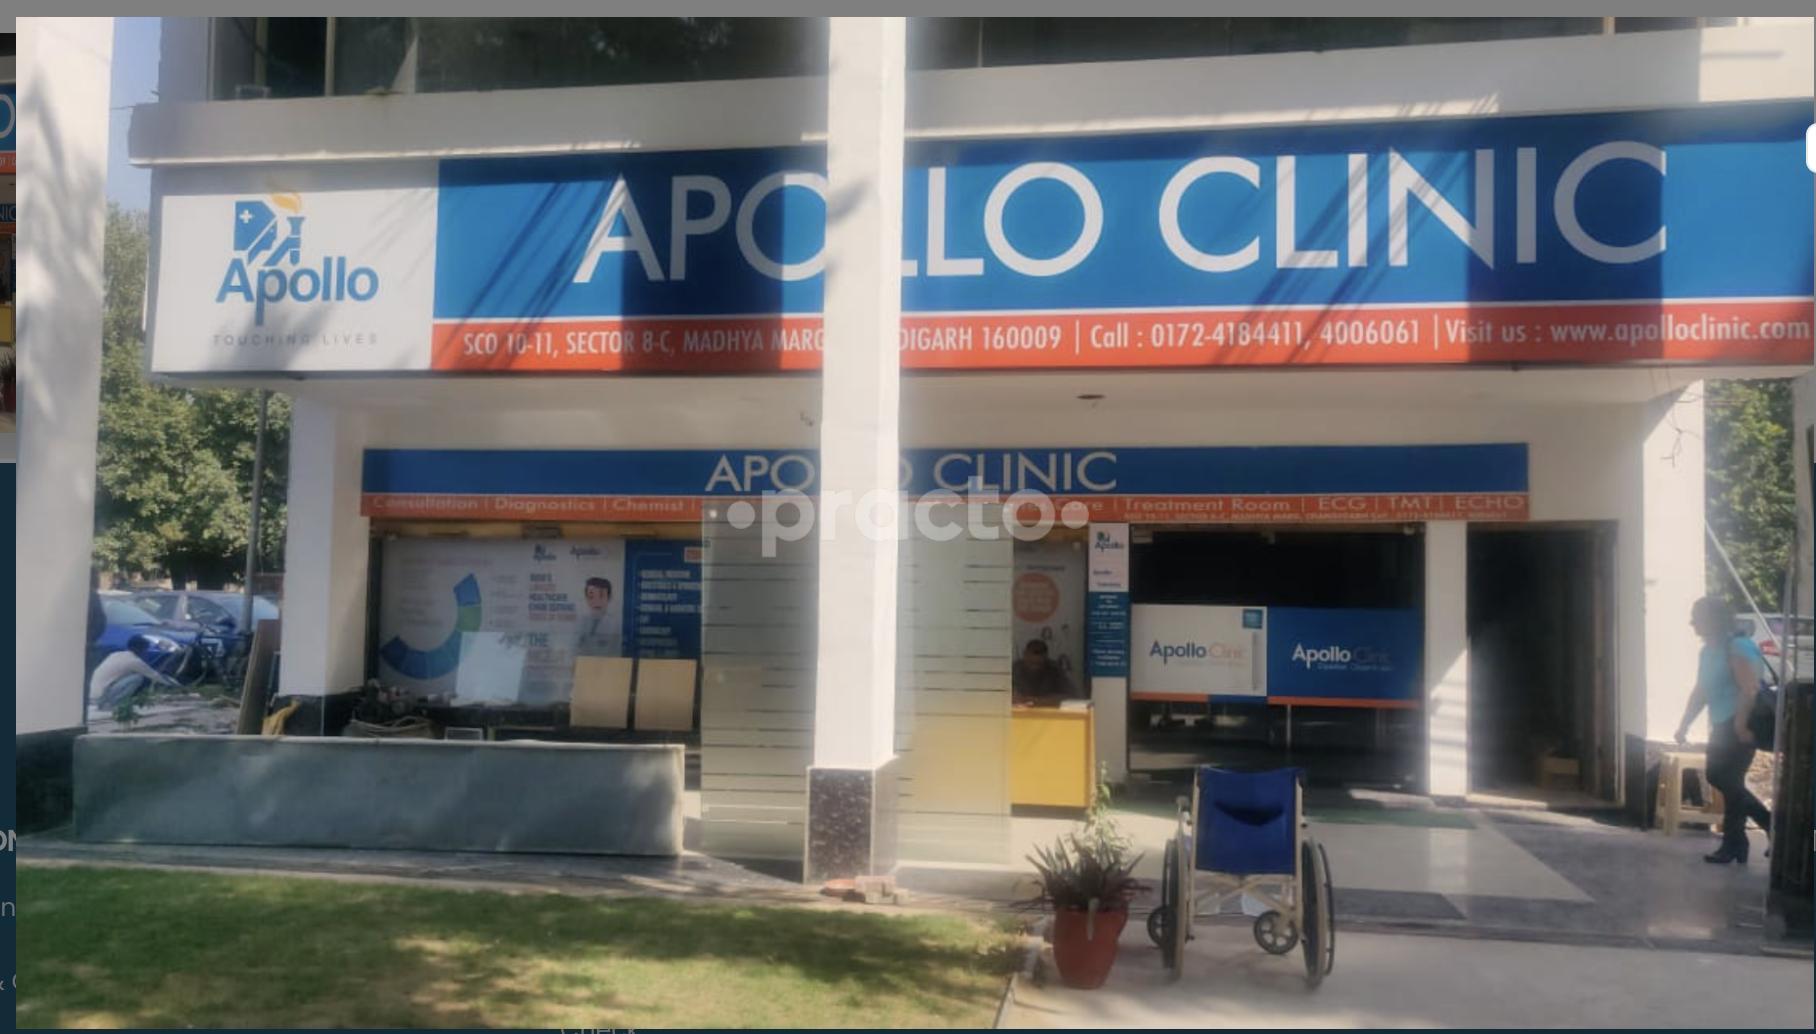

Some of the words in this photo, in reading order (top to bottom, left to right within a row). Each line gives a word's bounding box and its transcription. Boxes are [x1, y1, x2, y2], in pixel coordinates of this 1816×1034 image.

[573, 161, 1104, 282] APOLO
[1158, 140, 1668, 271] CLINIC
[215, 256, 379, 327] Apollo
[213, 333, 311, 346] TOUCHING
[323, 333, 378, 346] LIVES
[463, 332, 497, 355] SCO
[507, 331, 558, 359] 10-11,
[566, 330, 633, 354] SECTOR
[641, 329, 676, 357] 8-C,
[683, 329, 764, 352] MADHYA
[898, 326, 973, 351] DIGARH
[982, 325, 1061, 350] 160009
[1090, 322, 1129, 348] Call
[1151, 320, 1311, 351] 0172-4184411,
[1320, 319, 1420, 346] 4006061
[1445, 317, 1493, 344] Visit
[1501, 321, 1527, 343] us
[1550, 313, 1810, 347] www.apolloclinic.com
[933, 452, 1117, 492] CLINIC
[494, 497, 596, 513] Diagnostics
[613, 497, 685, 512] Chemist
[1123, 497, 1223, 512] Treatment
[1231, 497, 1291, 511] Room
[1318, 496, 1367, 511] ECG
[1389, 495, 1432, 510] TMT
[1455, 495, 1524, 510] ECHO
[1150, 640, 1207, 665] Apollo
[1291, 643, 1351, 669] Apollo
